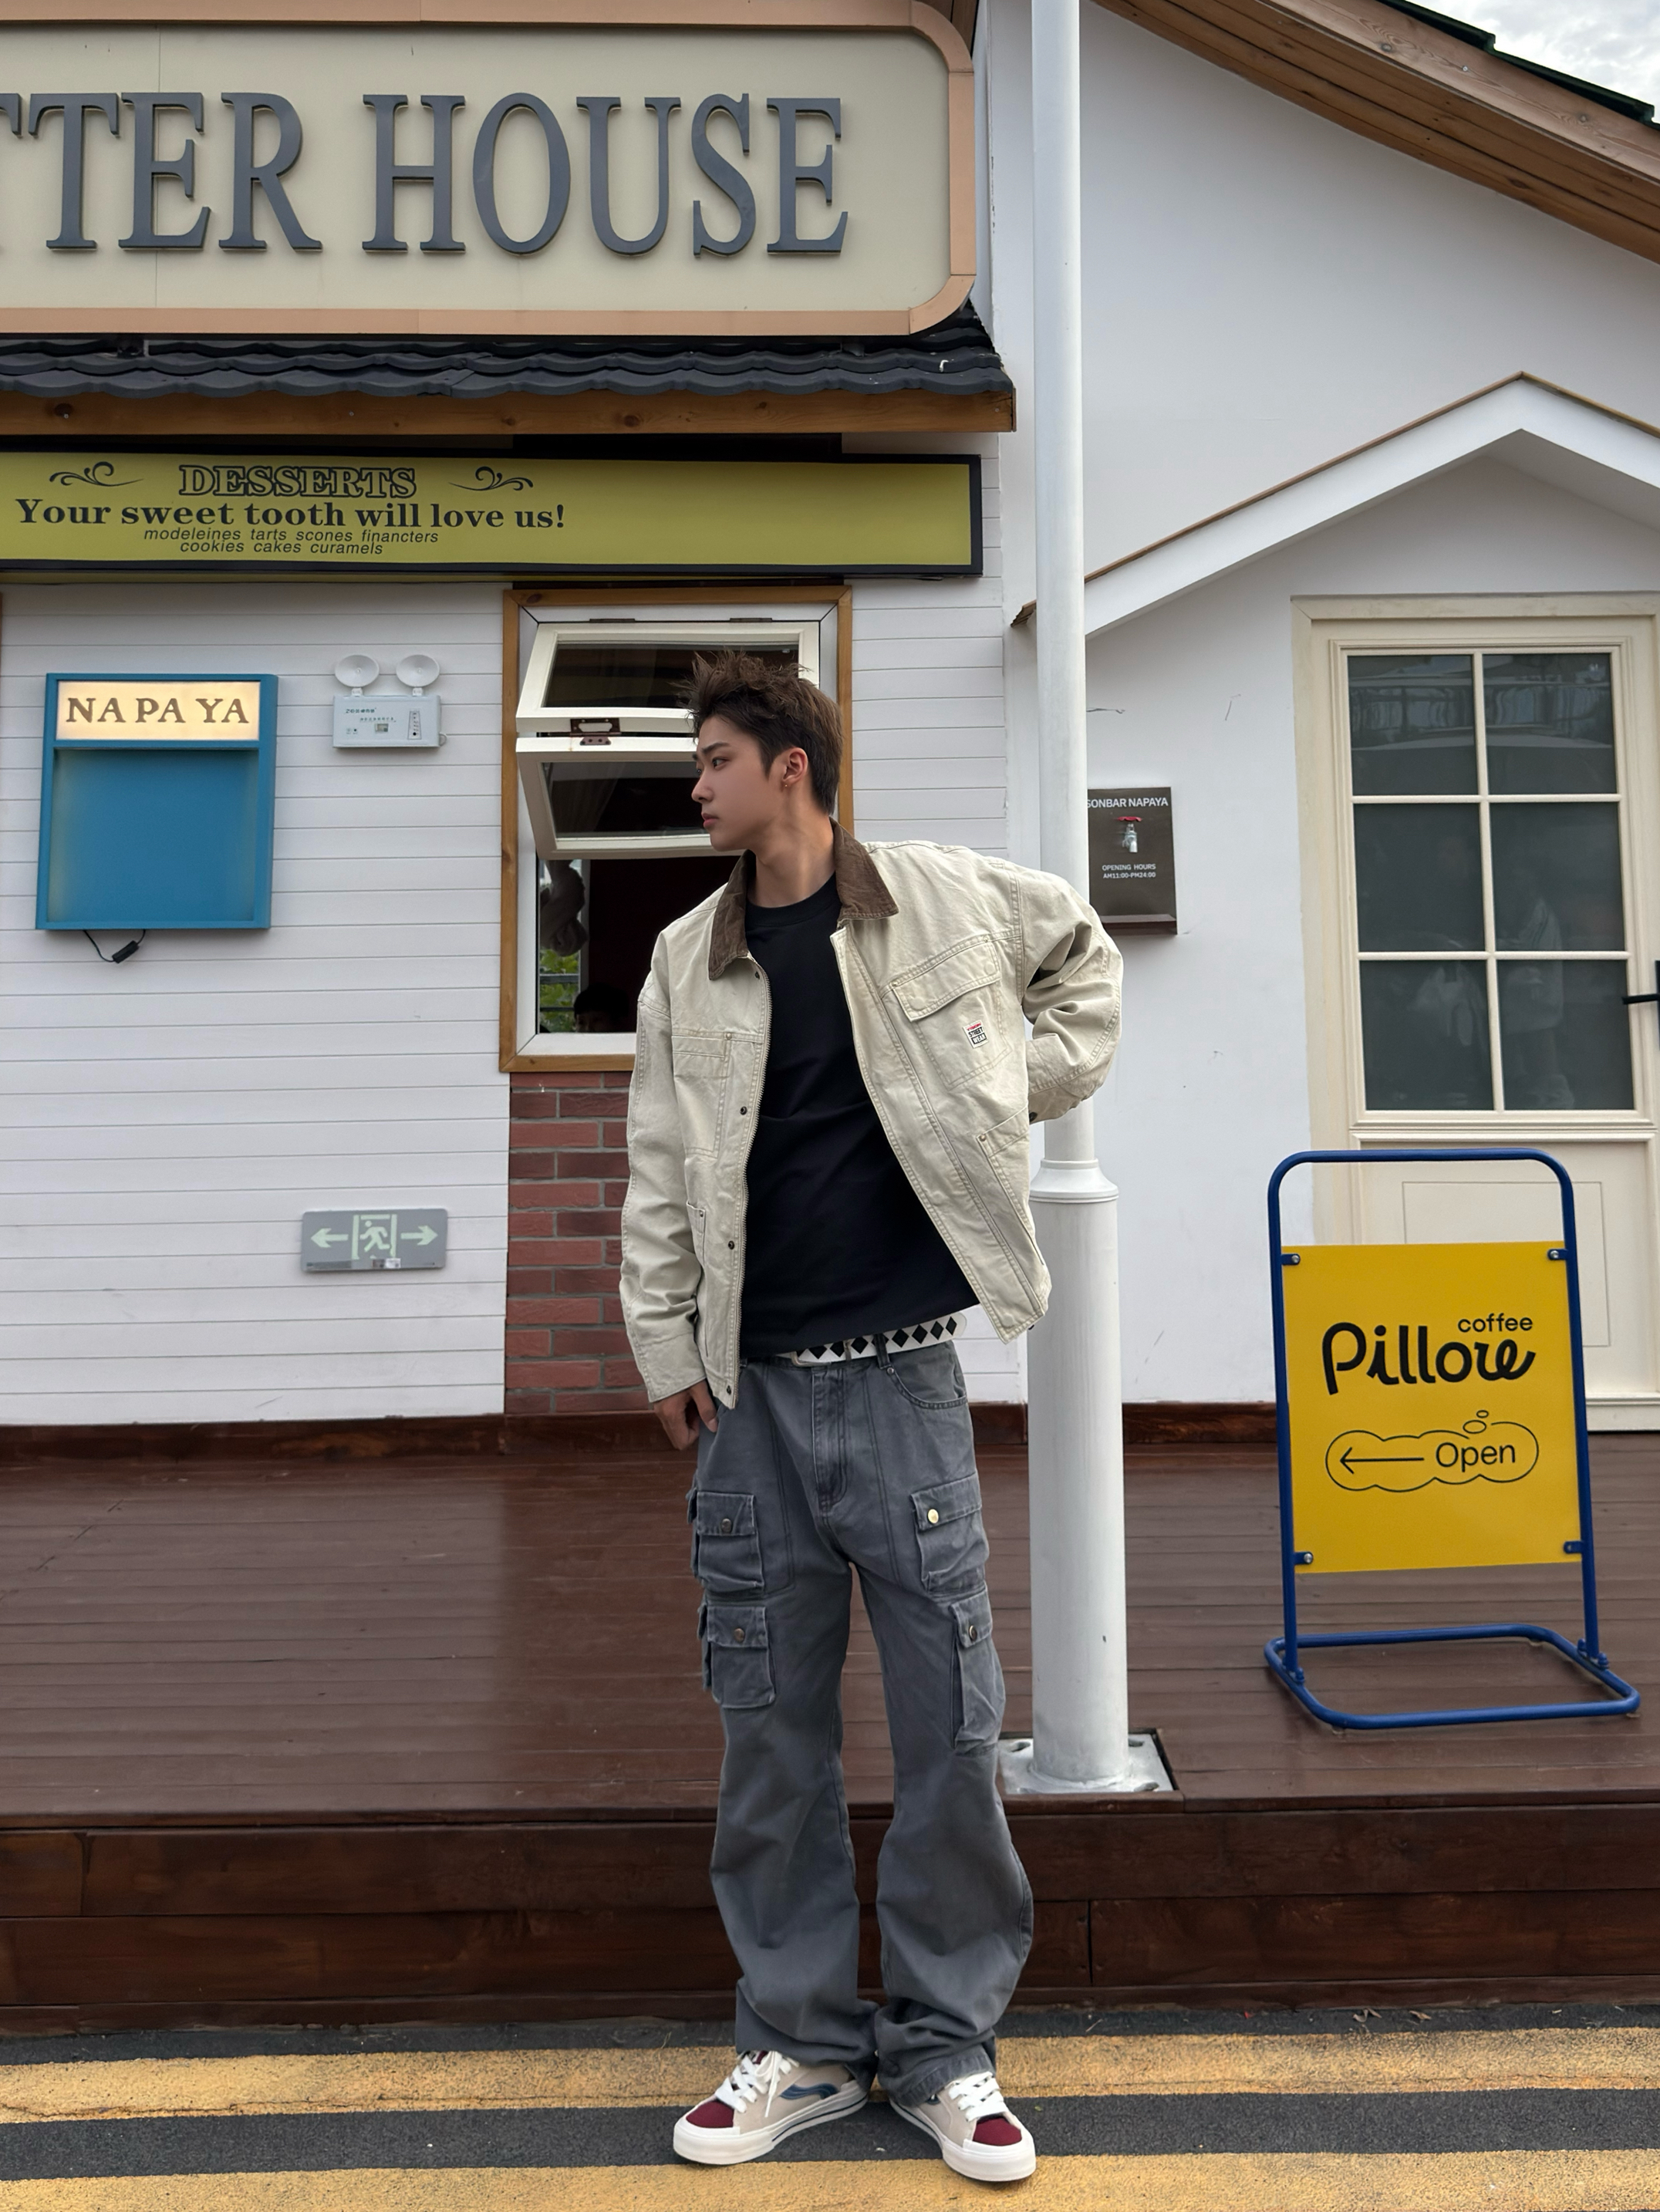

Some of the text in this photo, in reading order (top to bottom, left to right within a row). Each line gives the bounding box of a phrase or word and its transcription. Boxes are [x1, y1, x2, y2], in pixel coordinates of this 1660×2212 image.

[0, 93, 849, 256] TER HOUSE
[178, 464, 417, 498] DESSERTS
[15, 498, 564, 528] Your sweet tooth will love us!
[144, 528, 241, 540] modeleines
[251, 528, 286, 541] tarts
[295, 531, 353, 541] scones
[181, 540, 245, 552] cookies
[254, 541, 302, 553] cakes
[1128, 797, 1169, 808] NAPAYA
[968, 1027, 984, 1037] STREET
[972, 1034, 987, 1044] WEAR
[1457, 1313, 1533, 1333] coffee
[1436, 1442, 1516, 1473] Open
